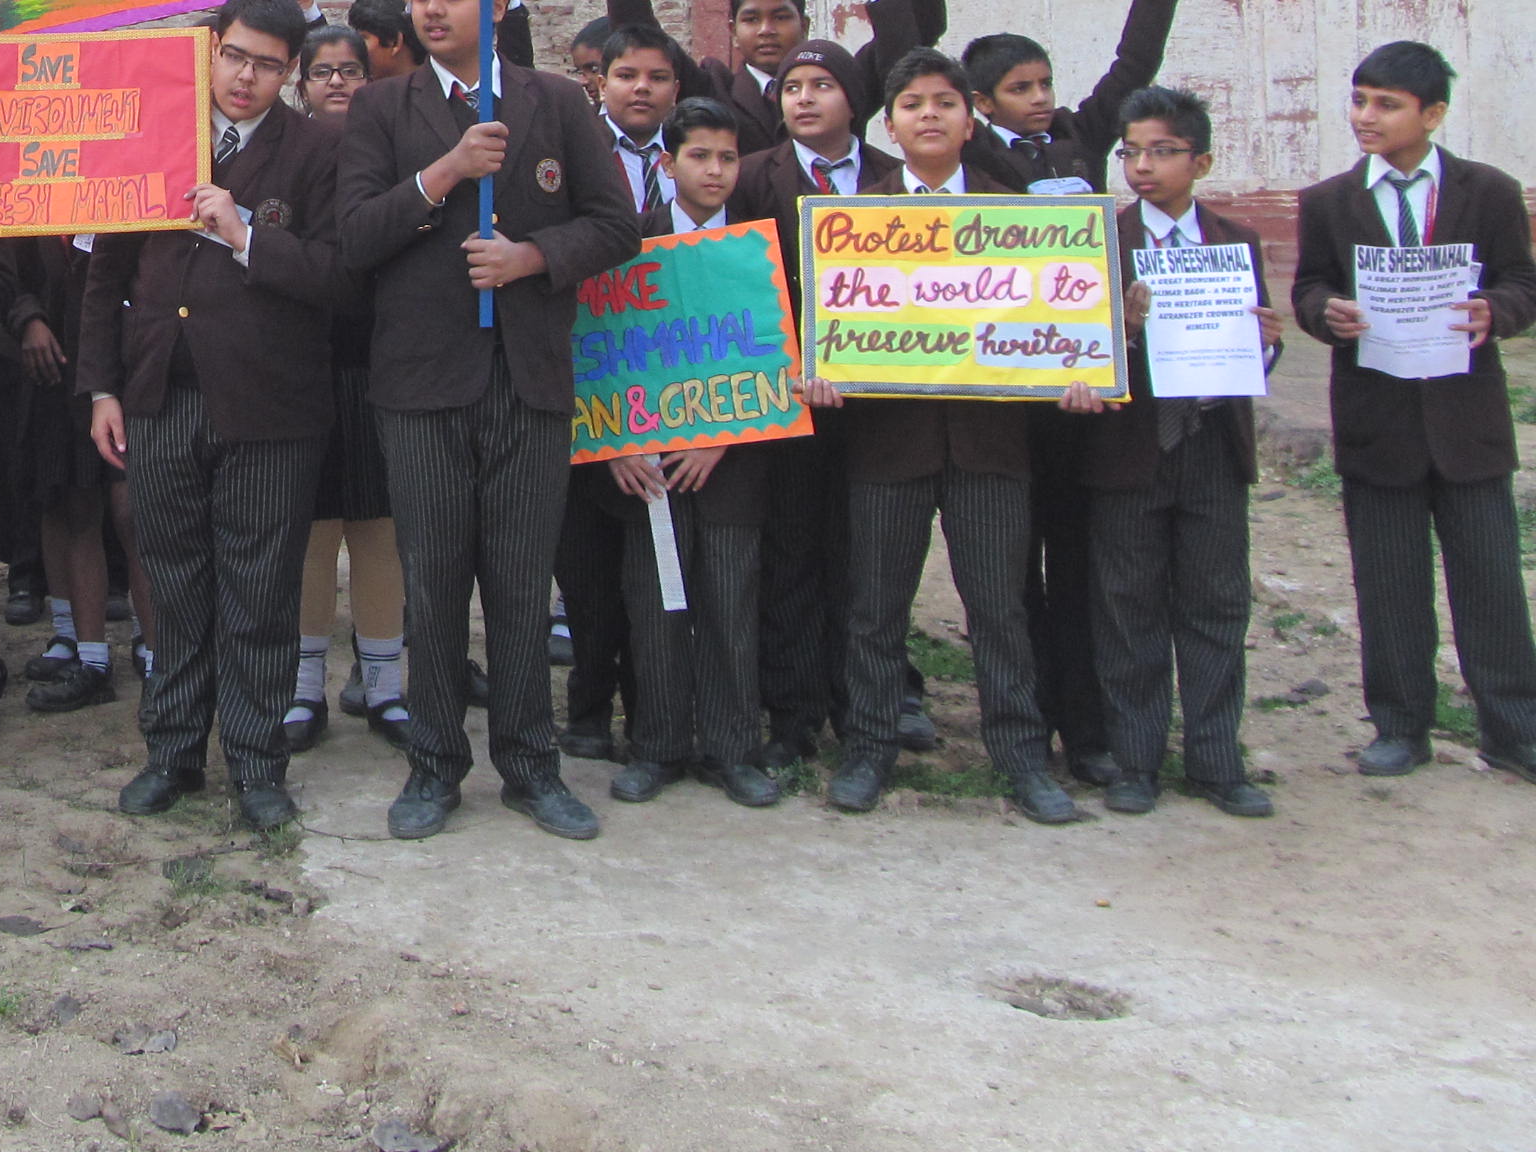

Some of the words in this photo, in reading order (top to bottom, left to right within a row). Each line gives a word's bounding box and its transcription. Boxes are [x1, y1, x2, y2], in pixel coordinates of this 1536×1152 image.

[21, 43, 75, 84] SAVE
[22, 141, 79, 177] SAVE
[70, 174, 166, 224] MAHAL
[815, 211, 950, 254] Protest
[1136, 249, 1166, 276] SAVE
[1166, 245, 1250, 275] SHEESHMAHAL
[1357, 246, 1386, 273] SAVE
[1388, 245, 1469, 273] SHEESHMAHAL
[577, 262, 669, 317] MAKE
[824, 267, 901, 308] the
[914, 266, 1029, 303] world
[1048, 264, 1099, 303] to
[1152, 289, 1182, 297] ALIMAR
[816, 319, 972, 363] preserve
[976, 322, 1112, 368] heritage
[626, 385, 661, 435] &
[659, 367, 791, 429] GREEN
